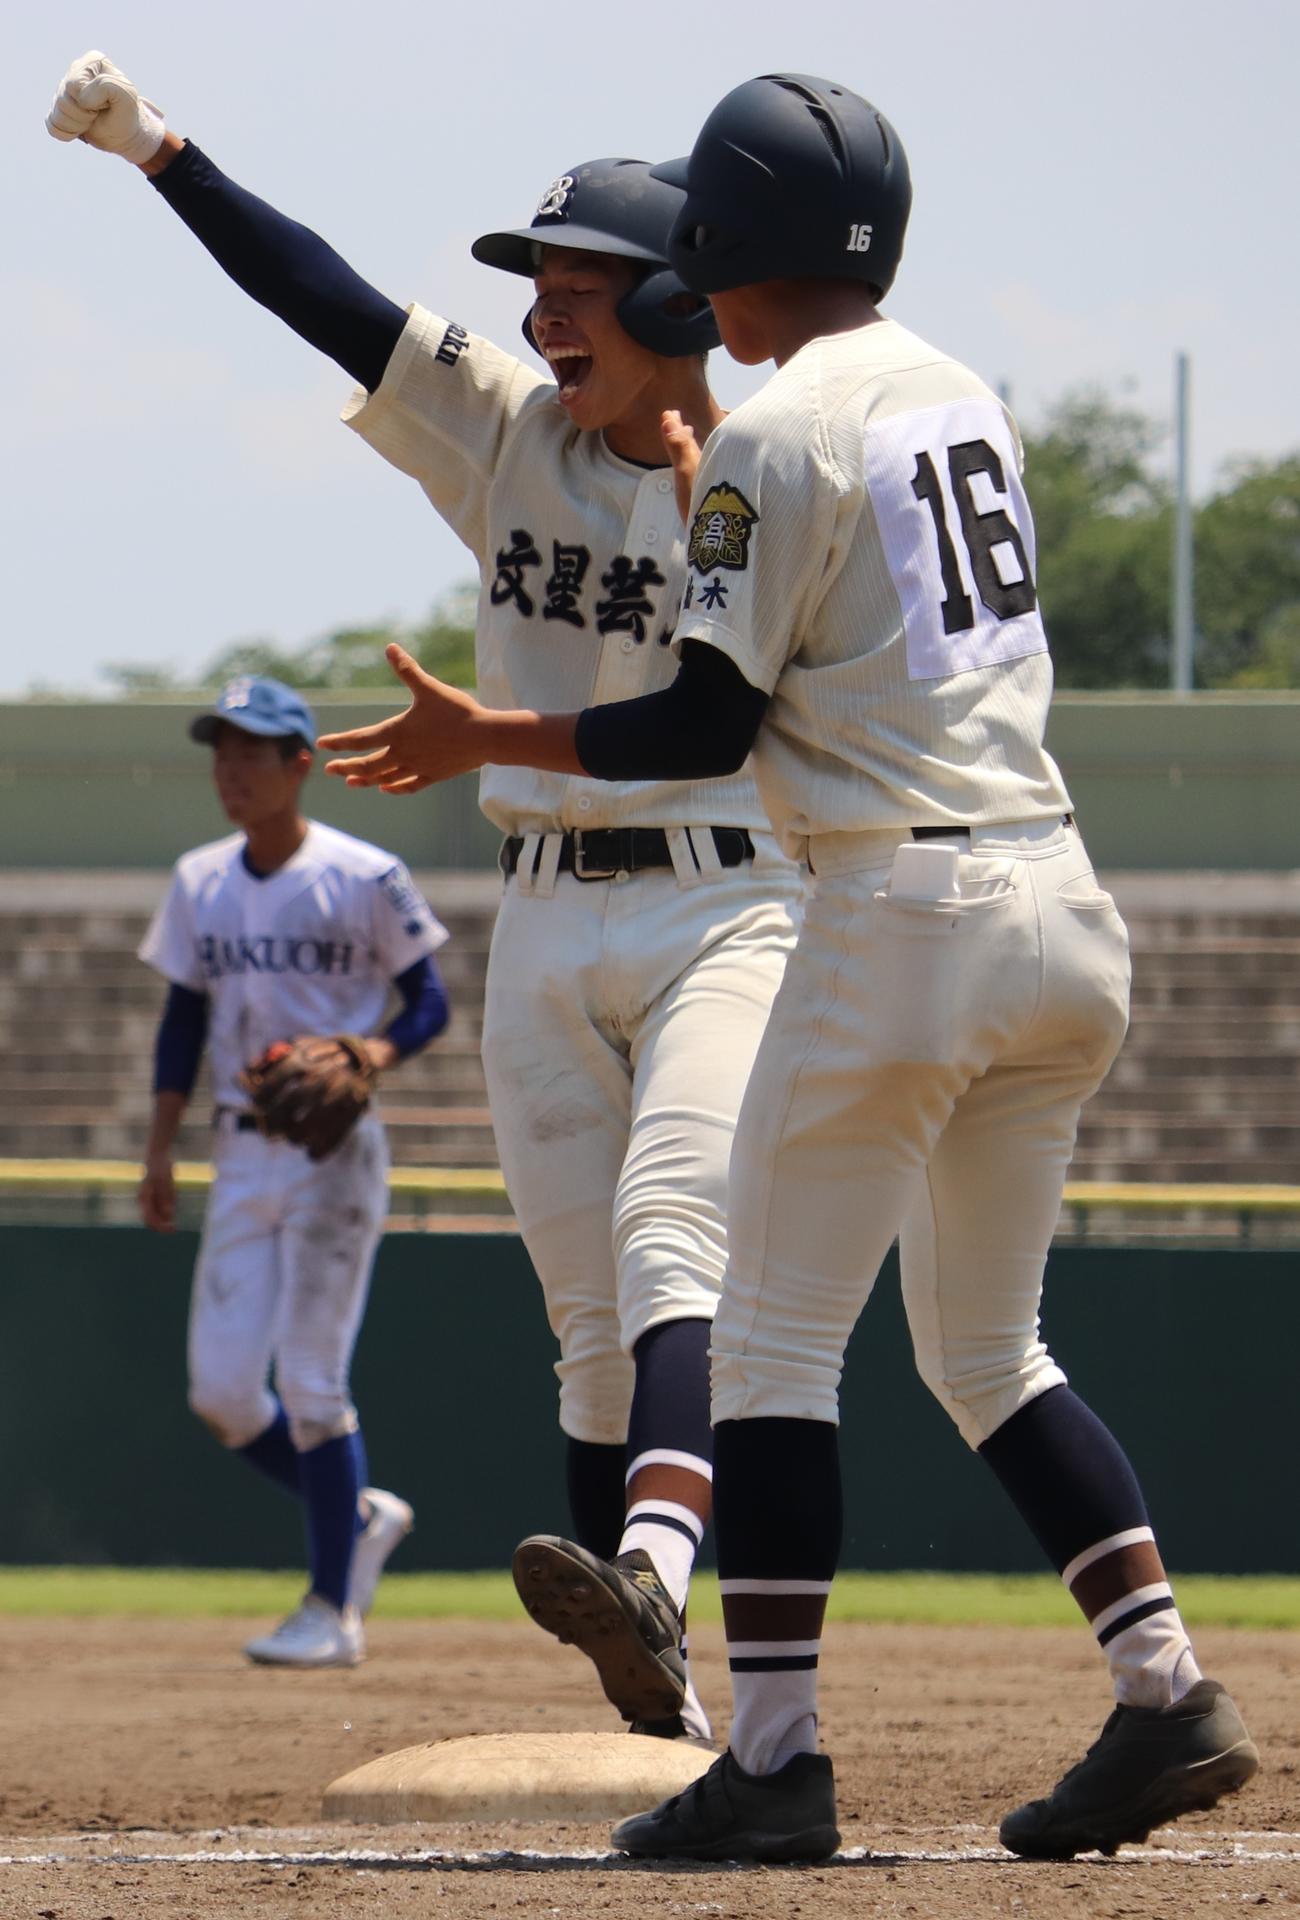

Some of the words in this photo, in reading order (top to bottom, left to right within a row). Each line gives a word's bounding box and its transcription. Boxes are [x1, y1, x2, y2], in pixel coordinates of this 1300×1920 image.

[846, 223, 873, 252] 16
[434, 320, 470, 367] aku
[910, 438, 1037, 636] 16
[490, 528, 677, 646] 文星芸
